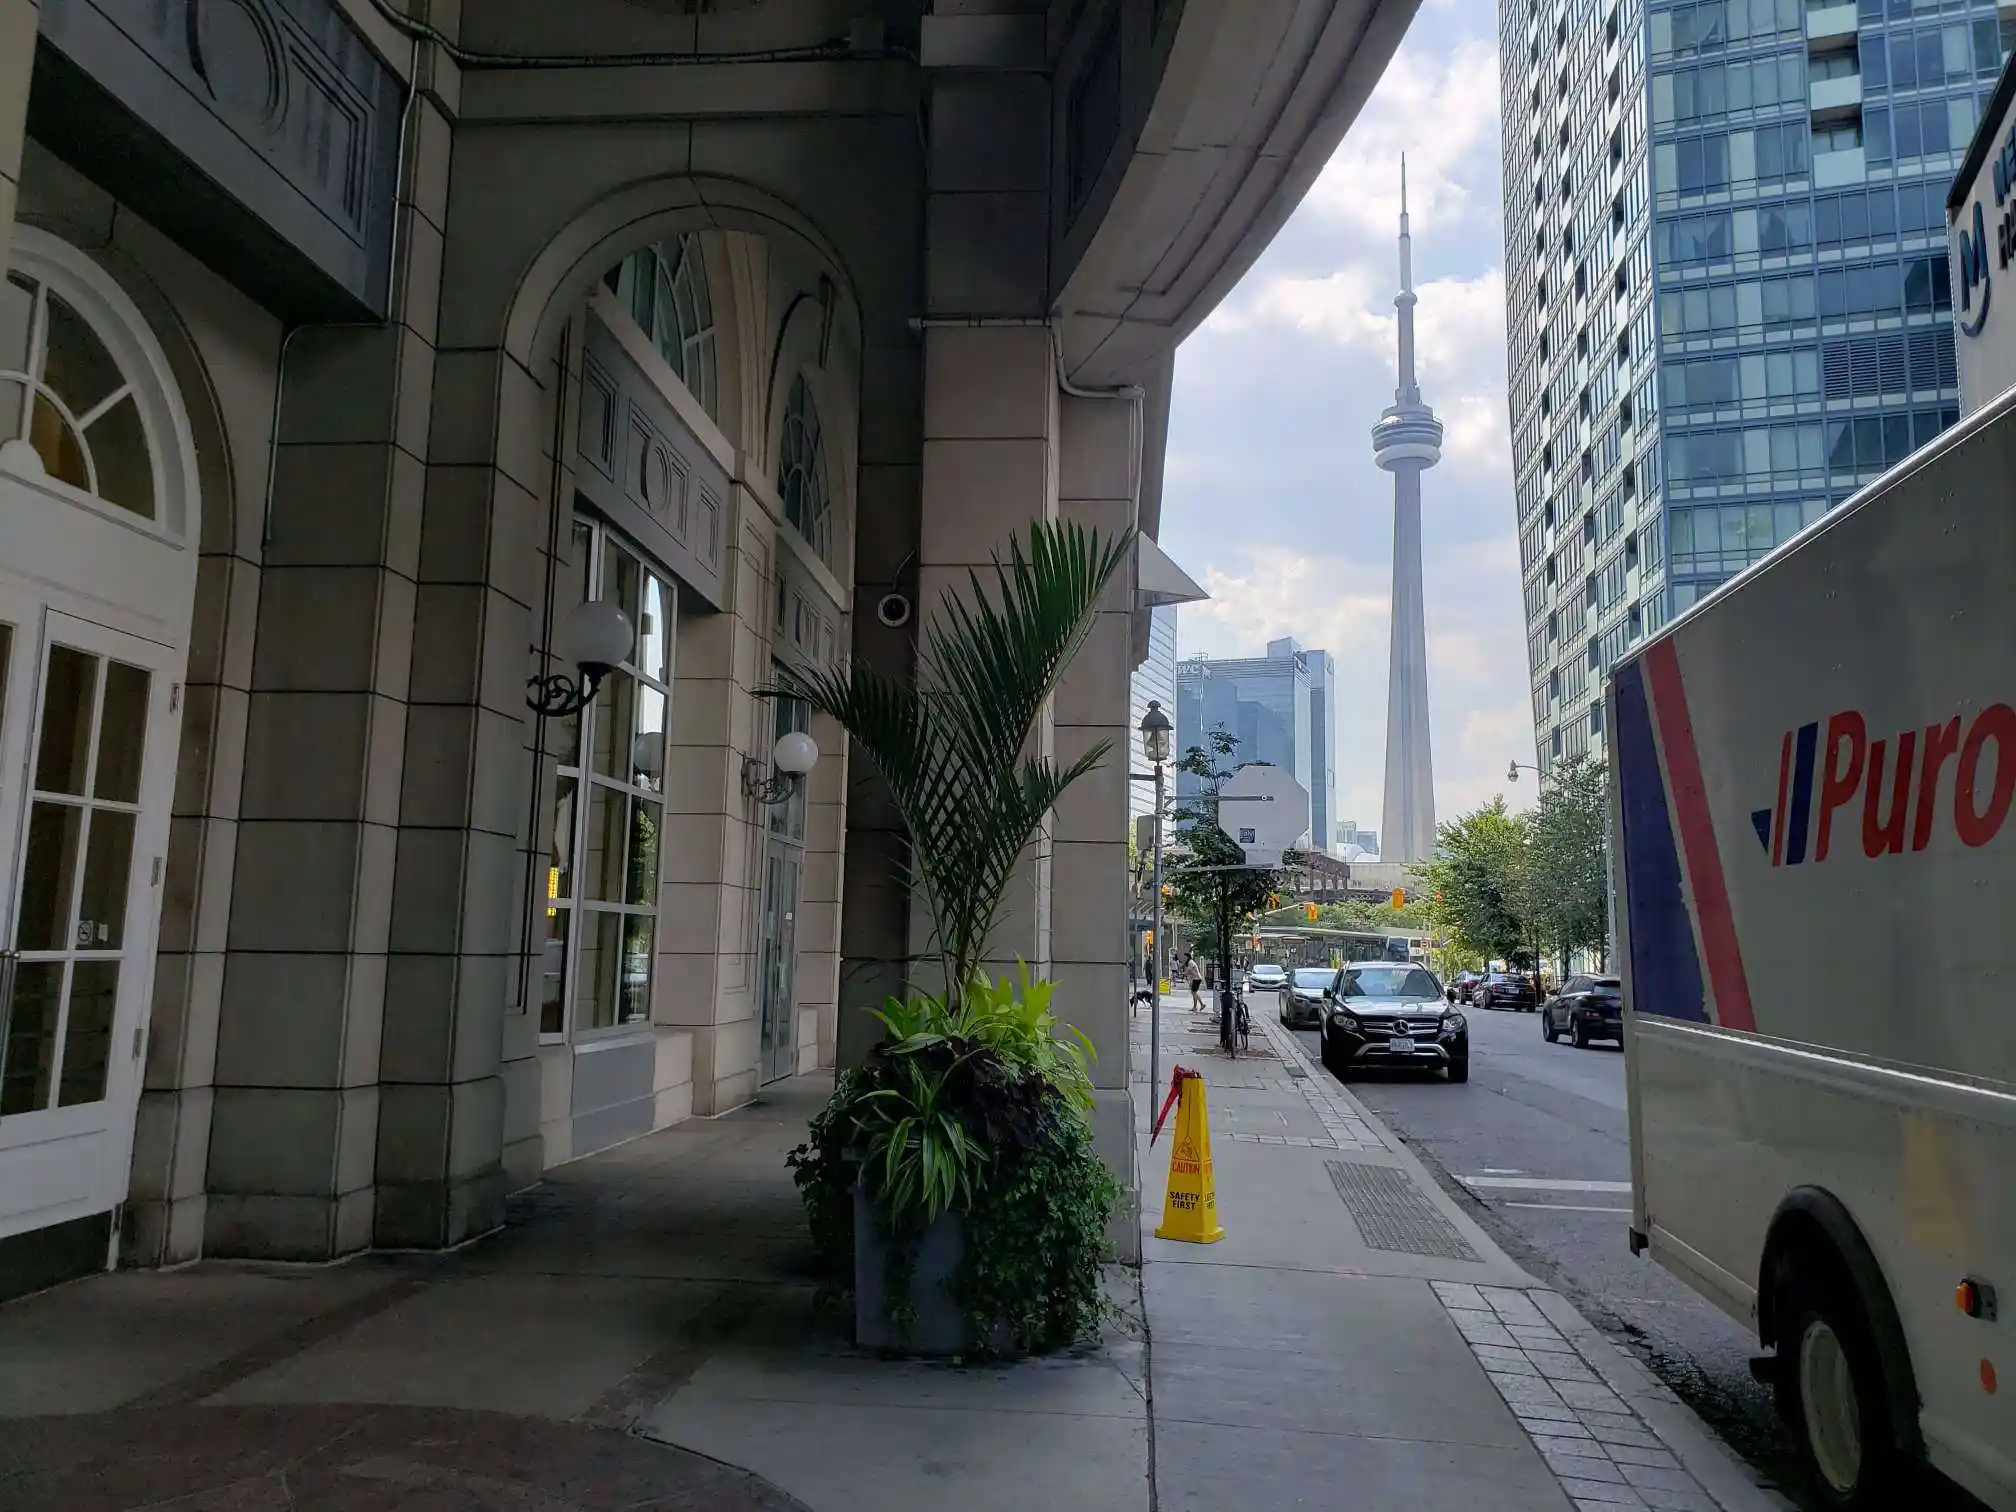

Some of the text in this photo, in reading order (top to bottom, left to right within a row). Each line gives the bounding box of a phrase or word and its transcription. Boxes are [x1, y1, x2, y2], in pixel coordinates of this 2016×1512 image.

[1172, 1161, 1200, 1174] CAUTION
[1169, 1191, 1200, 1202] SAFETY
[1172, 1200, 1196, 1211] FIRST
